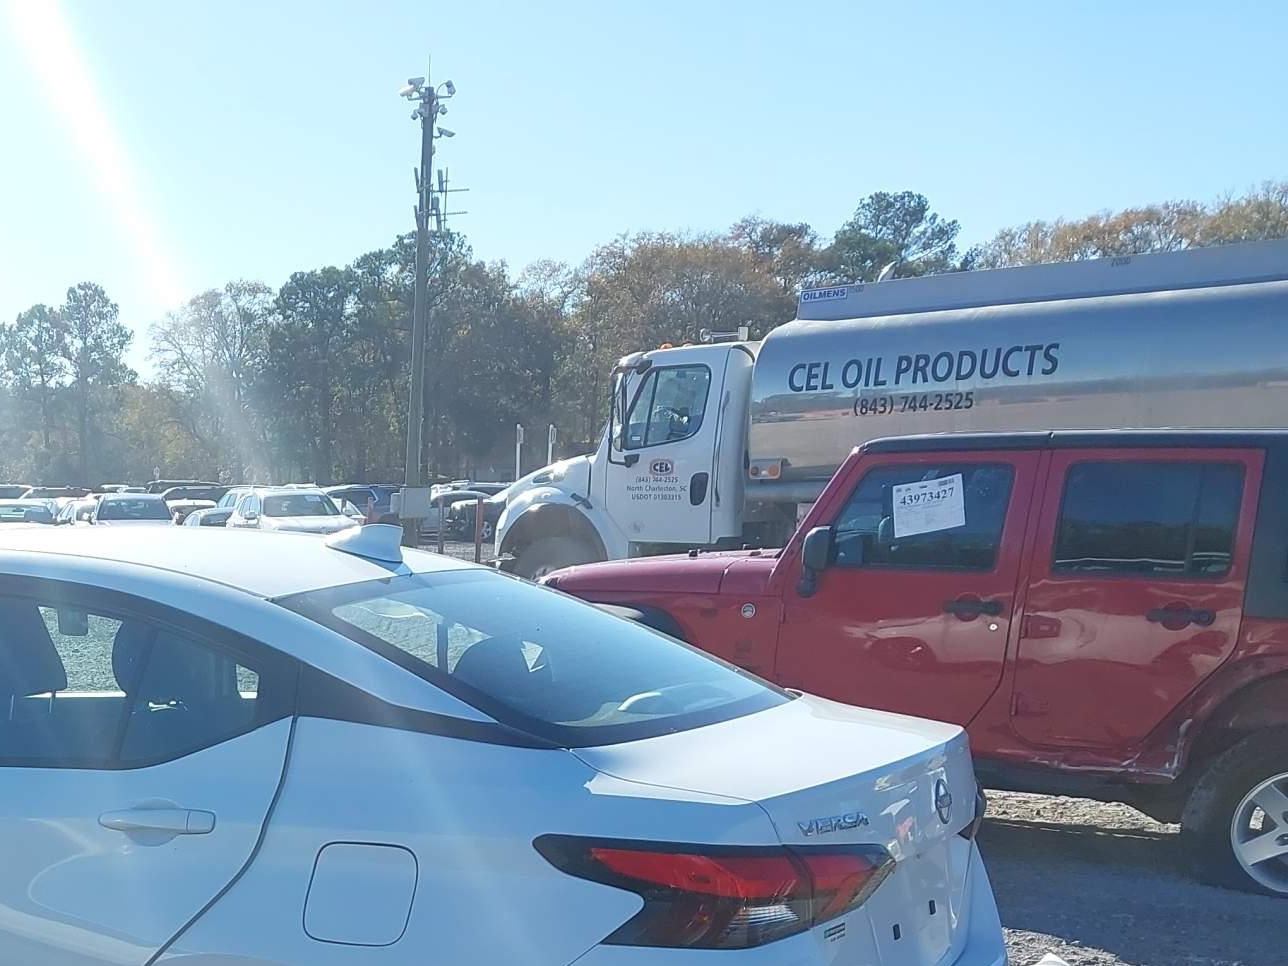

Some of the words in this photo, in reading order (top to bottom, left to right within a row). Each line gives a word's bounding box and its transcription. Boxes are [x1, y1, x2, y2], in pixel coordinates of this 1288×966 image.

[803, 288, 846, 301] OILMENS
[788, 361, 834, 393] CEL
[841, 356, 887, 389] OIL
[894, 343, 1060, 385] PRODUCTS
[854, 396, 894, 417] (843)
[900, 392, 974, 413] 744-2525
[653, 462, 670, 473] CEL
[899, 487, 955, 506] 43973427
[797, 811, 869, 837] VERSA
